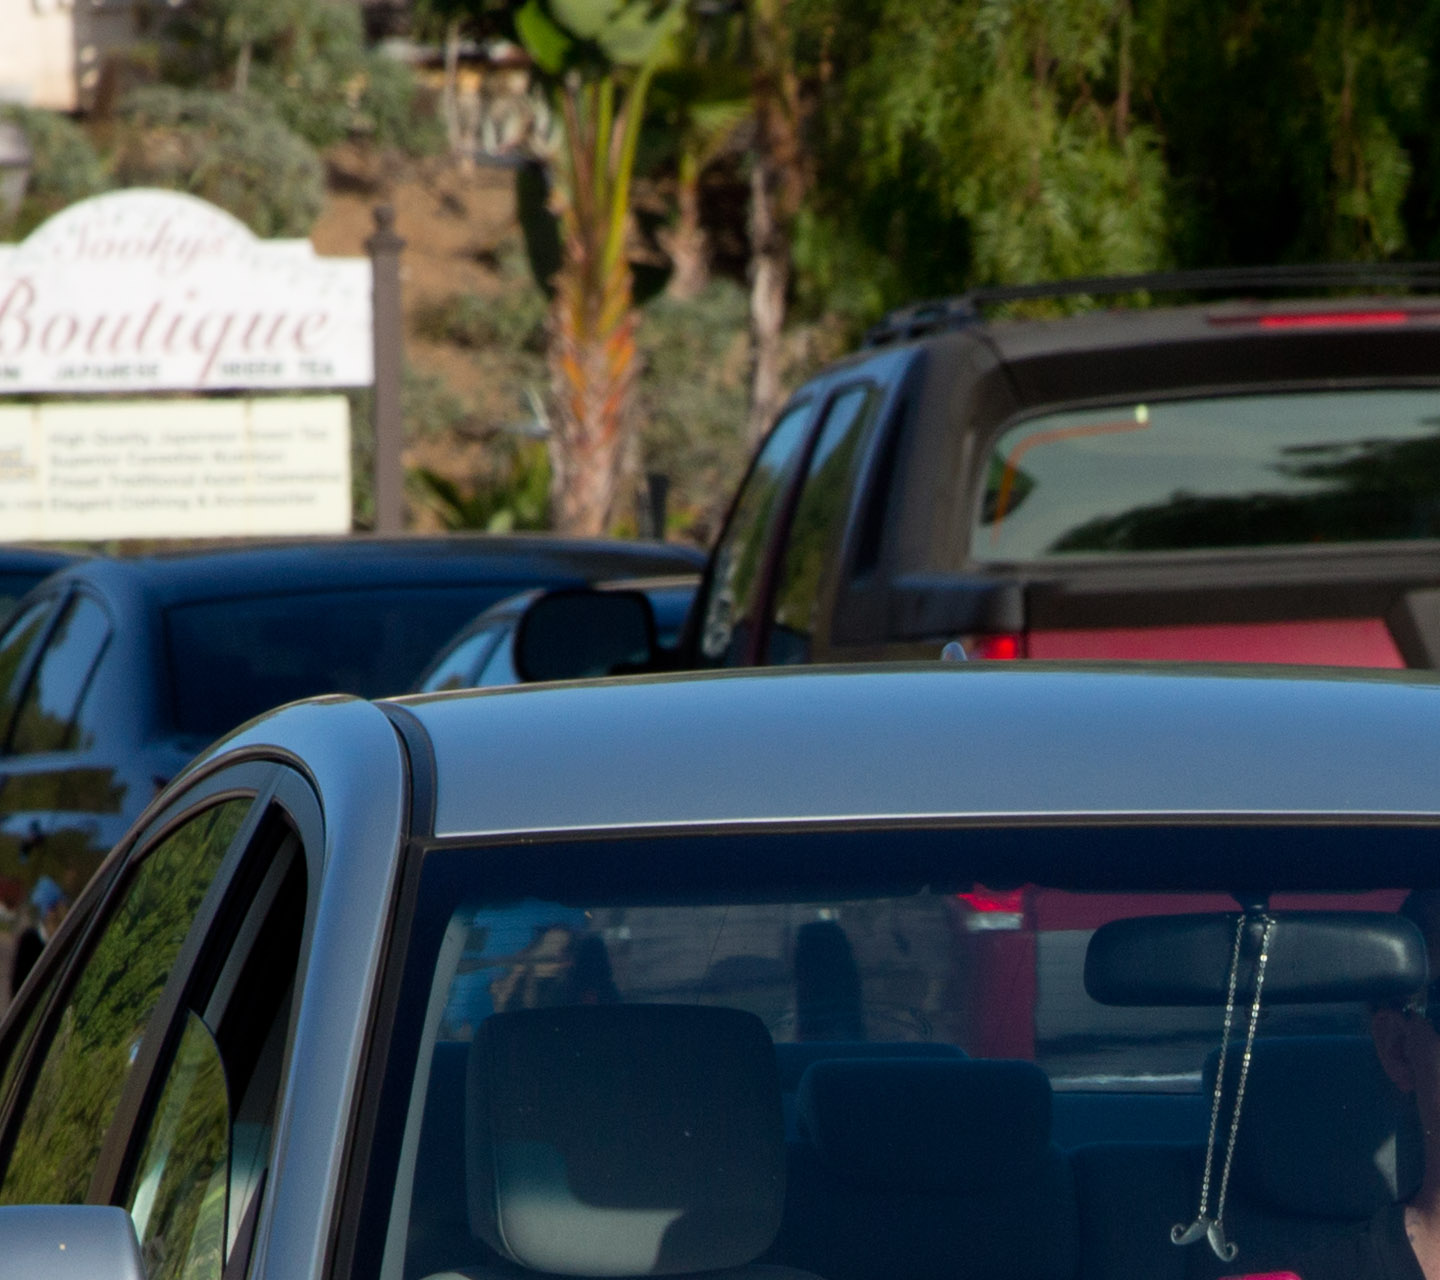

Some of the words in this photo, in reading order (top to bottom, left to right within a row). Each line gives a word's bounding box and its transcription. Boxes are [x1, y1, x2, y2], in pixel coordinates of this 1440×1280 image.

[57, 363, 160, 380] JAPANESE
[220, 360, 284, 377] GREEN
[298, 359, 335, 376] TEA
